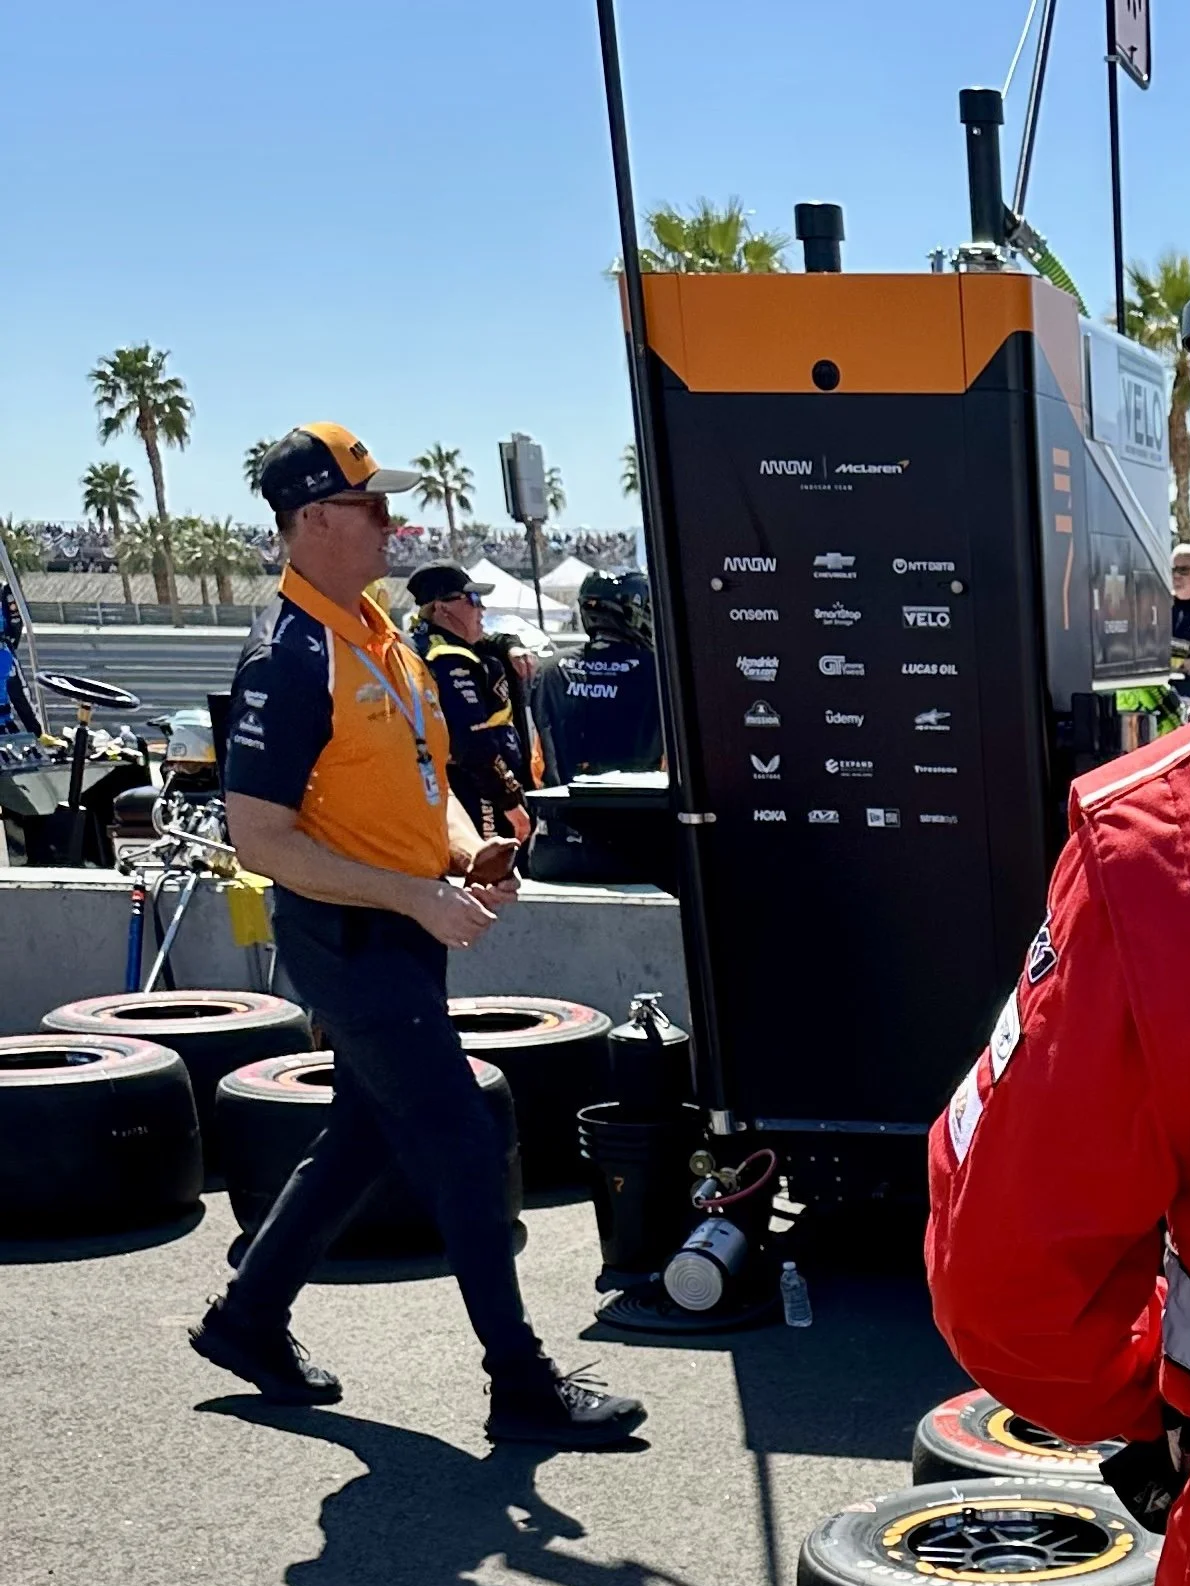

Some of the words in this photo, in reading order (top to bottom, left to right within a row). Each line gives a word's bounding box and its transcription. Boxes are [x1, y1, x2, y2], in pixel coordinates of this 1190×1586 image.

[1122, 374, 1164, 451] VELO
[759, 460, 813, 475] ARROW
[834, 462, 905, 475] McLaren
[723, 557, 777, 573] ARROW
[729, 608, 780, 621] onsemi
[904, 612, 951, 627] VELO
[901, 663, 938, 675] LUCAS
[939, 664, 958, 675] OIL
[753, 809, 787, 822] HOKA
